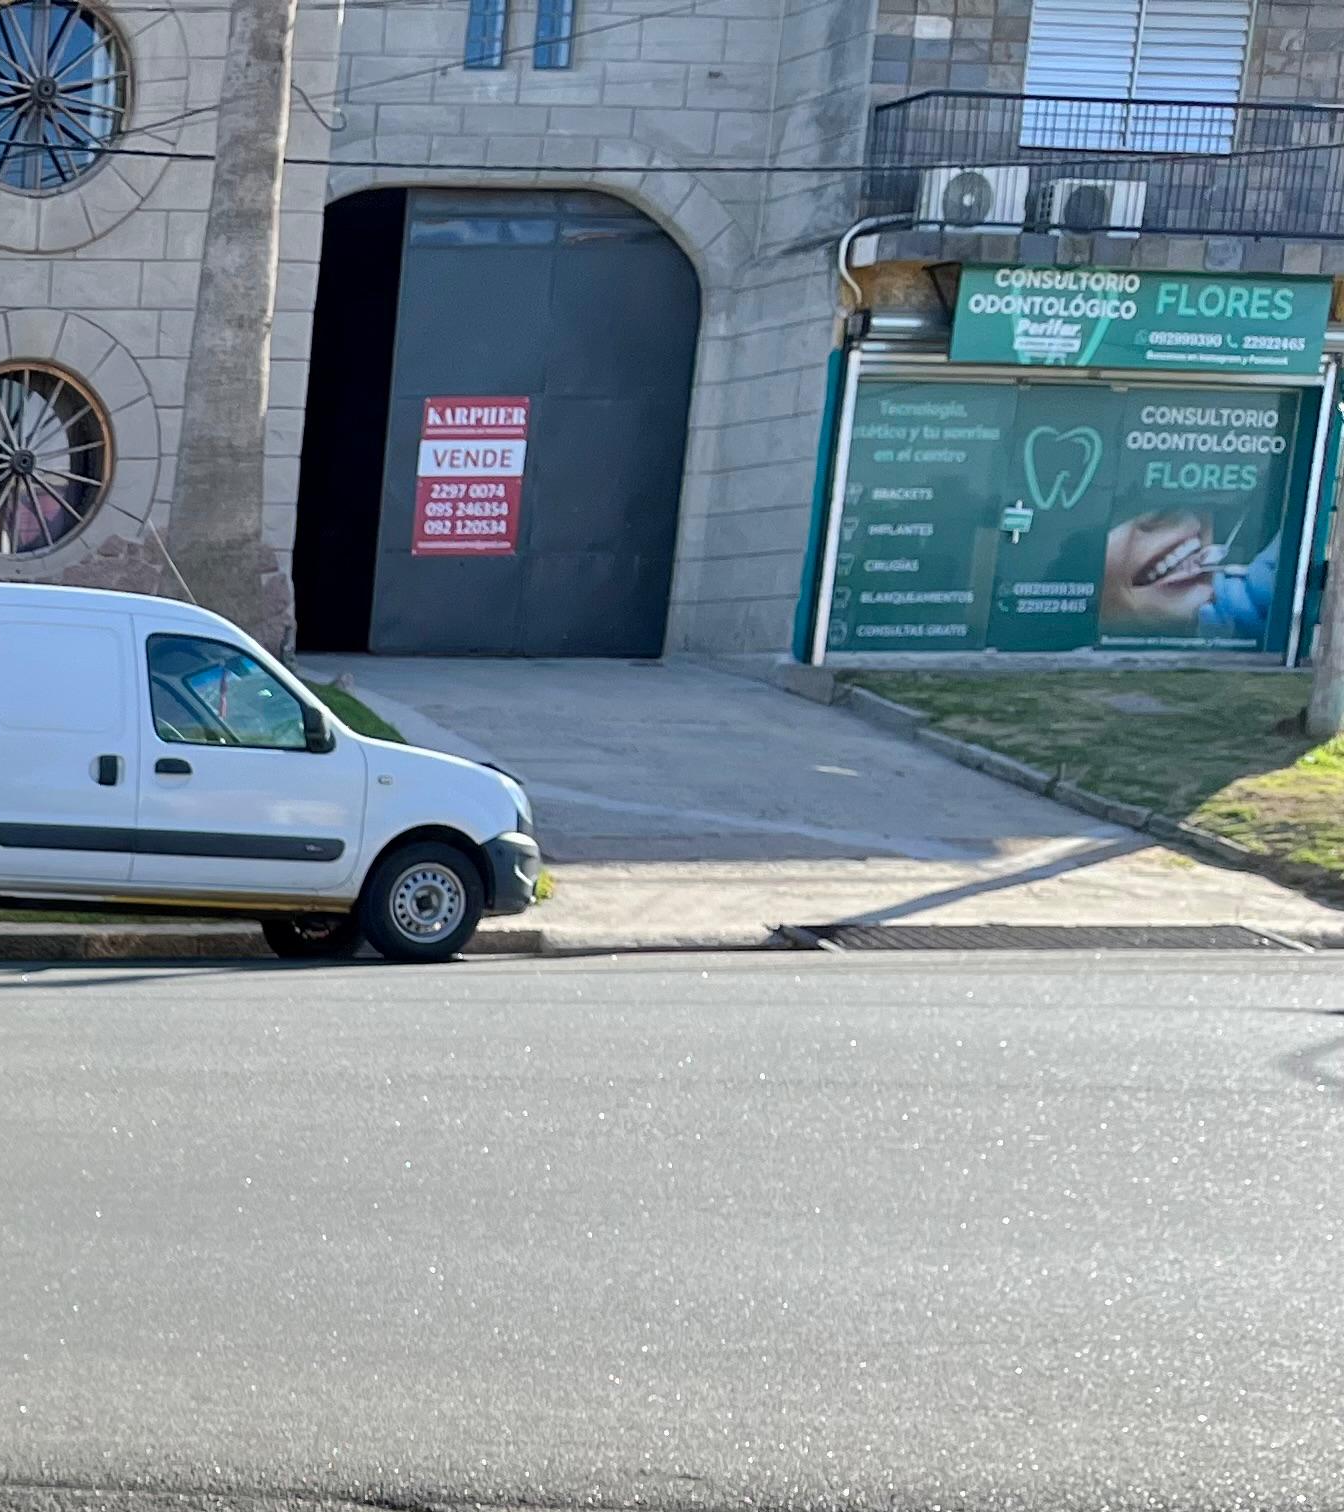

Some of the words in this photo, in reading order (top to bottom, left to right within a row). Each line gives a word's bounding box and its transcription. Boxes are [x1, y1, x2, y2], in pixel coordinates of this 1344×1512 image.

[995, 268, 1140, 293] CONSULTORIO
[968, 293, 1137, 320] ODONTOLÓGICO
[1156, 283, 1294, 320] FLORES
[427, 407, 527, 425] KARPHER
[1141, 405, 1279, 428] CONSULTORIO
[1126, 430, 1286, 454] ODONTOLÓGICO
[433, 449, 514, 468] VENDE
[1144, 462, 1258, 490] FLORES
